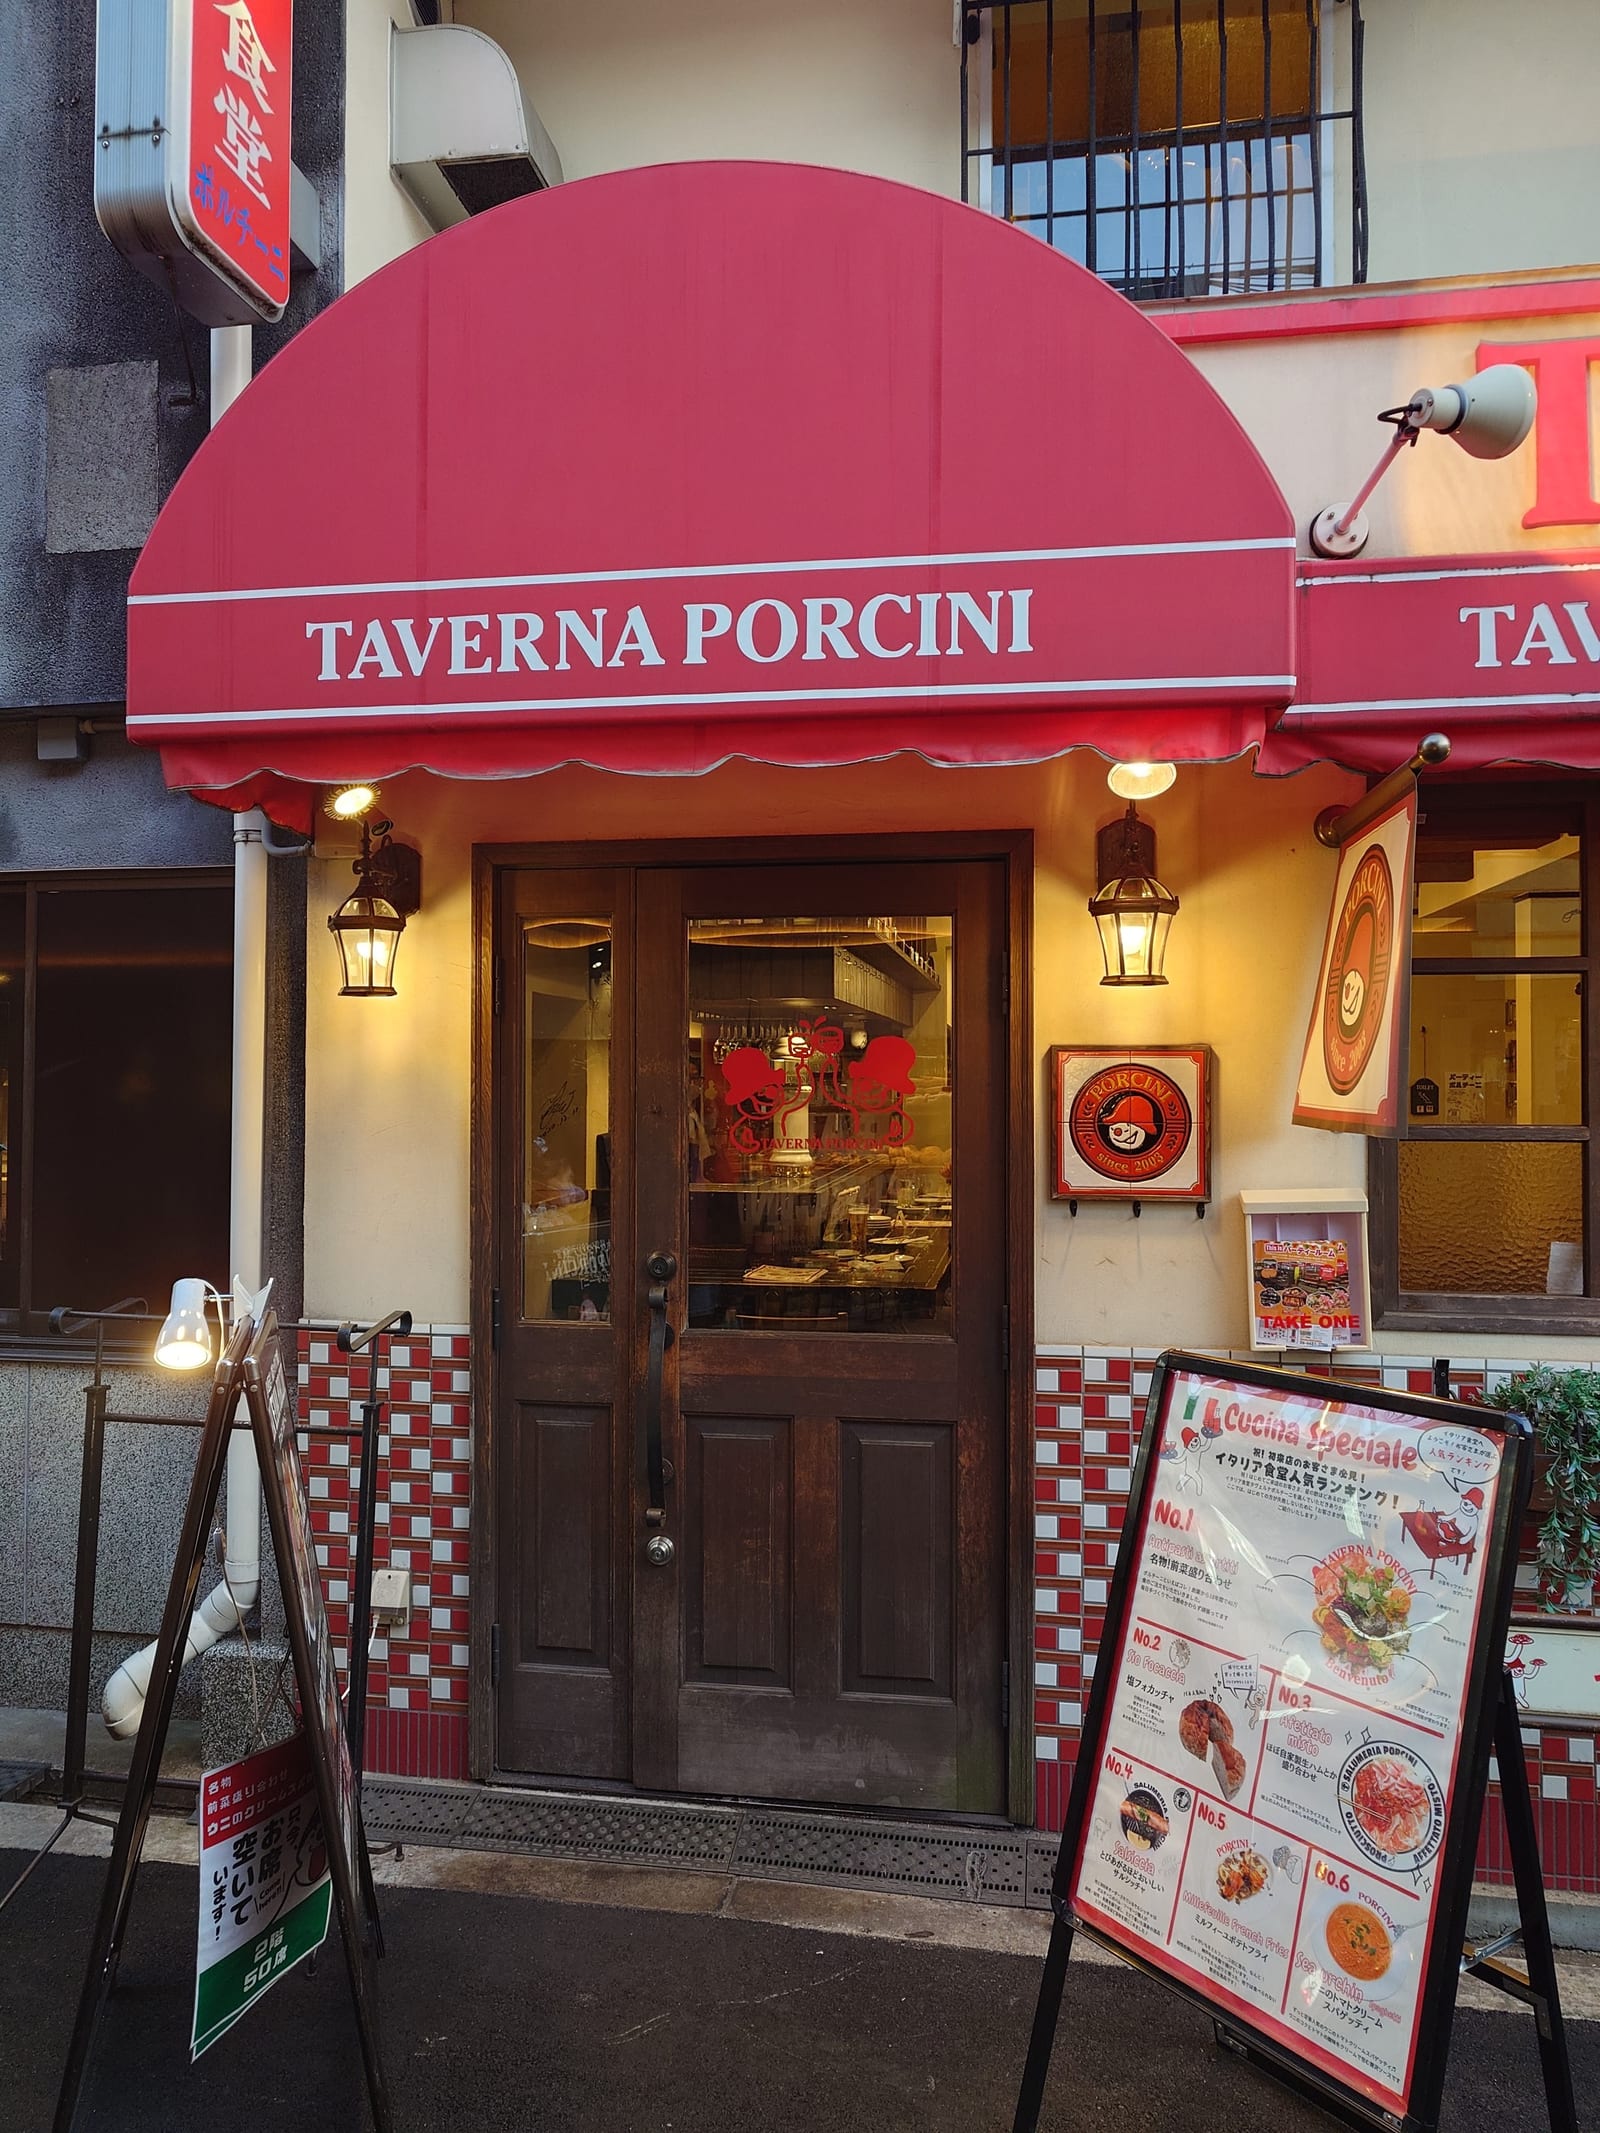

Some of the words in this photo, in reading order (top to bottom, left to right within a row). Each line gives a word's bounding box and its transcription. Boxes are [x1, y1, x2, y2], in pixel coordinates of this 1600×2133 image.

[306, 604, 665, 681] TAVERNA
[683, 588, 1034, 664] PORCINI
[1342, 862, 1387, 930] PORCINI
[1331, 1036, 1346, 1073] since
[1089, 1072, 1173, 1101] PORCINI
[1449, 1073, 1482, 1081] パーティー
[760, 1137, 822, 1150] TAVERNA
[1096, 1151, 1129, 1174] since
[1134, 1151, 1164, 1172] 2003
[1261, 1315, 1312, 1329] TAKE
[1318, 1315, 1360, 1329] ONE
[1224, 1402, 1300, 1446] Cucina
[1306, 1420, 1418, 1472] Speciale
[1153, 1498, 1194, 1532] No.1
[1147, 1533, 1195, 1561] Antipasti
[1321, 1543, 1374, 1571] TAVERNA
[1376, 1548, 1418, 1596] PORCINI
[1132, 1627, 1162, 1651] No.2
[1141, 1655, 1187, 1685] Focaccia
[1125, 1673, 1175, 1705] 塩フォカッチャ
[1277, 1685, 1312, 1713] No.3
[1278, 1711, 1334, 1747] Afettato
[1286, 1731, 1320, 1757] misto
[1104, 1753, 1134, 1781] No.4
[1281, 1760, 1317, 1783] 盛り合わせ
[1342, 1745, 1383, 1784] SALUMERIA
[206, 1768, 289, 1816] 前菜盛り合わせ
[207, 1776, 233, 1796] 名物
[1133, 1780, 1170, 1815] SALUMERIA
[1427, 1782, 1445, 1819] MISTO
[1197, 1801, 1227, 1831] No.5
[258, 1818, 284, 1884] お席
[1112, 1839, 1156, 1876] Salsiccia
[1216, 1838, 1250, 1857] PORCINI
[230, 1831, 258, 1926] 空いて
[1099, 1849, 1165, 1894] とびあがるほどおいしい
[1112, 1868, 1146, 1894] サルシッチャ
[1314, 1859, 1351, 1893] No.6
[211, 1866, 228, 1942] います!
[1357, 1890, 1397, 1931] PORCINI
[254, 1927, 285, 1963] 2階
[1193, 1913, 1268, 1963] ミルフィーユポテトフライ
[1231, 1917, 1264, 1946] French
[1264, 1935, 1289, 1960] Fries
[242, 1946, 289, 1994] 50席
[1294, 1949, 1317, 1977] Sea
[1320, 1965, 1364, 2004] urchin
[1322, 1999, 1369, 2035] スパゲッティ
